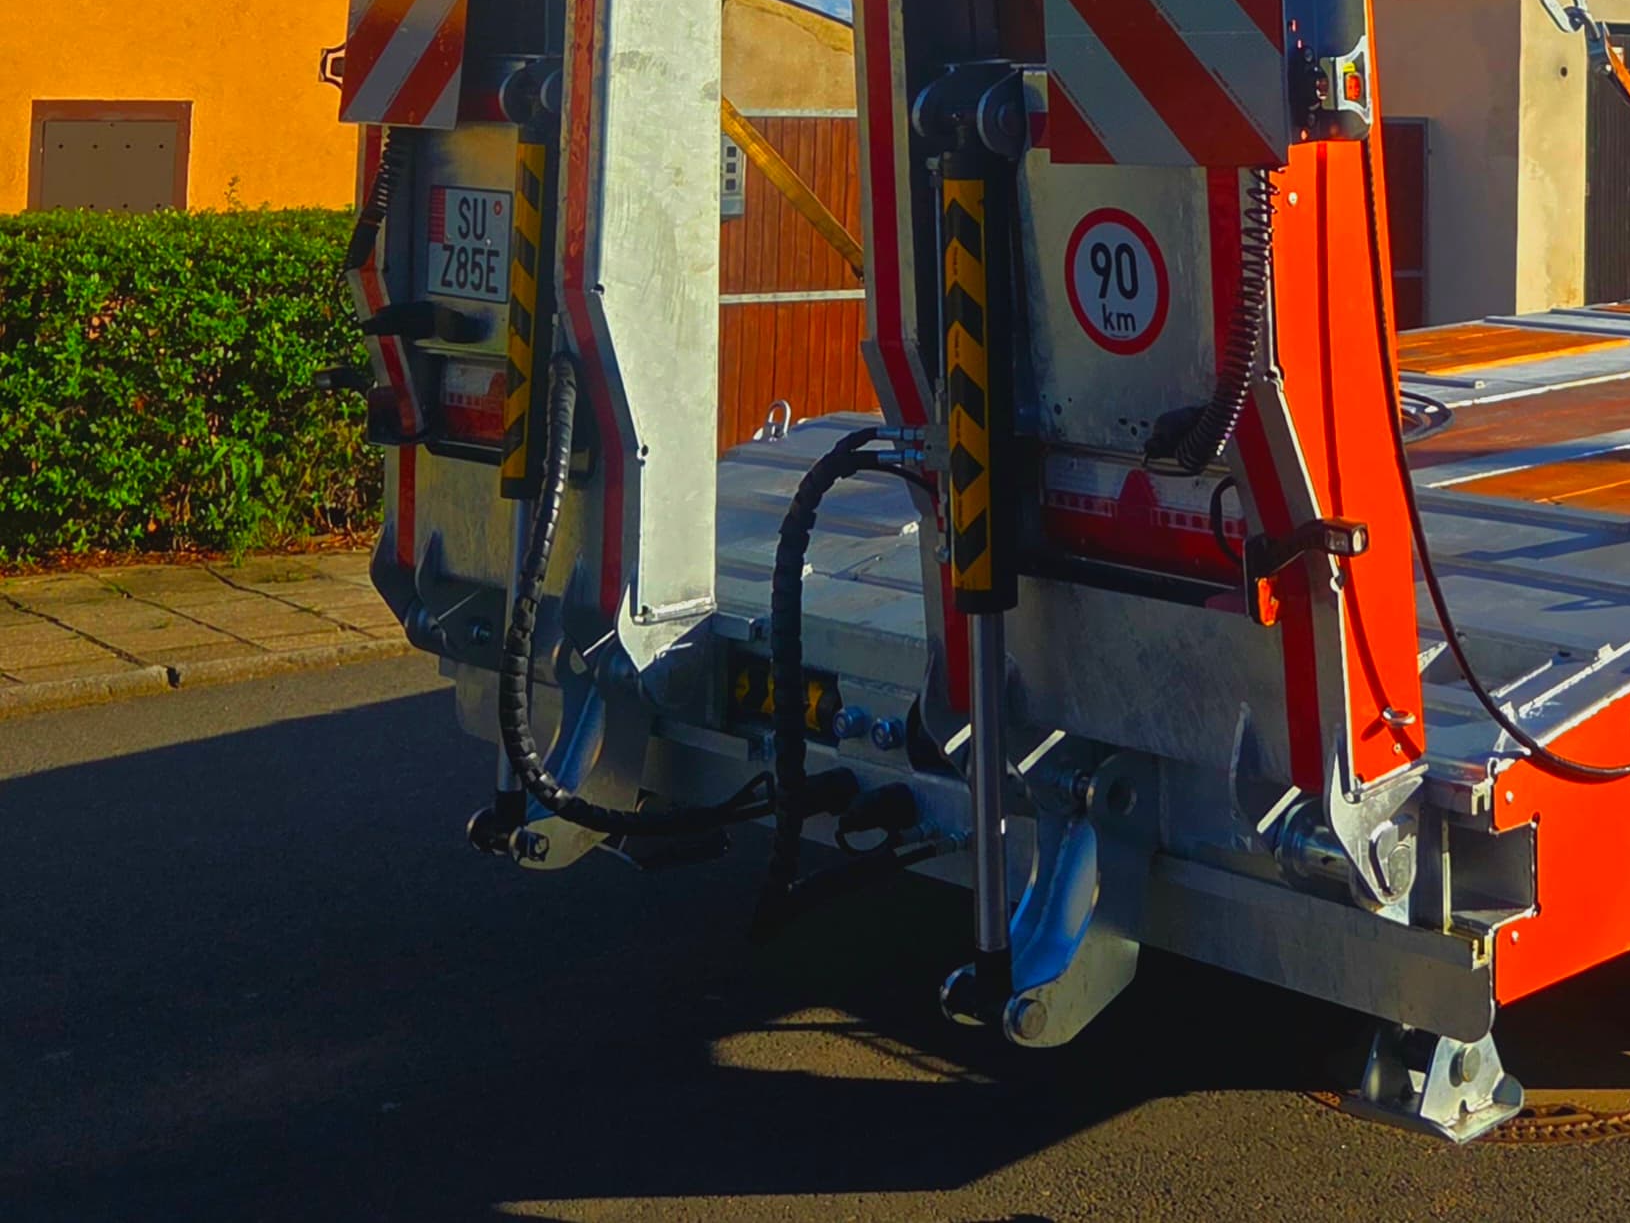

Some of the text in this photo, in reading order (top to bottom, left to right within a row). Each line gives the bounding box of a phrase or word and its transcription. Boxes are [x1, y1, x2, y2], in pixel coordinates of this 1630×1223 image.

[458, 197, 486, 240] SU
[1090, 242, 1139, 300] 90
[1102, 303, 1136, 332] km
